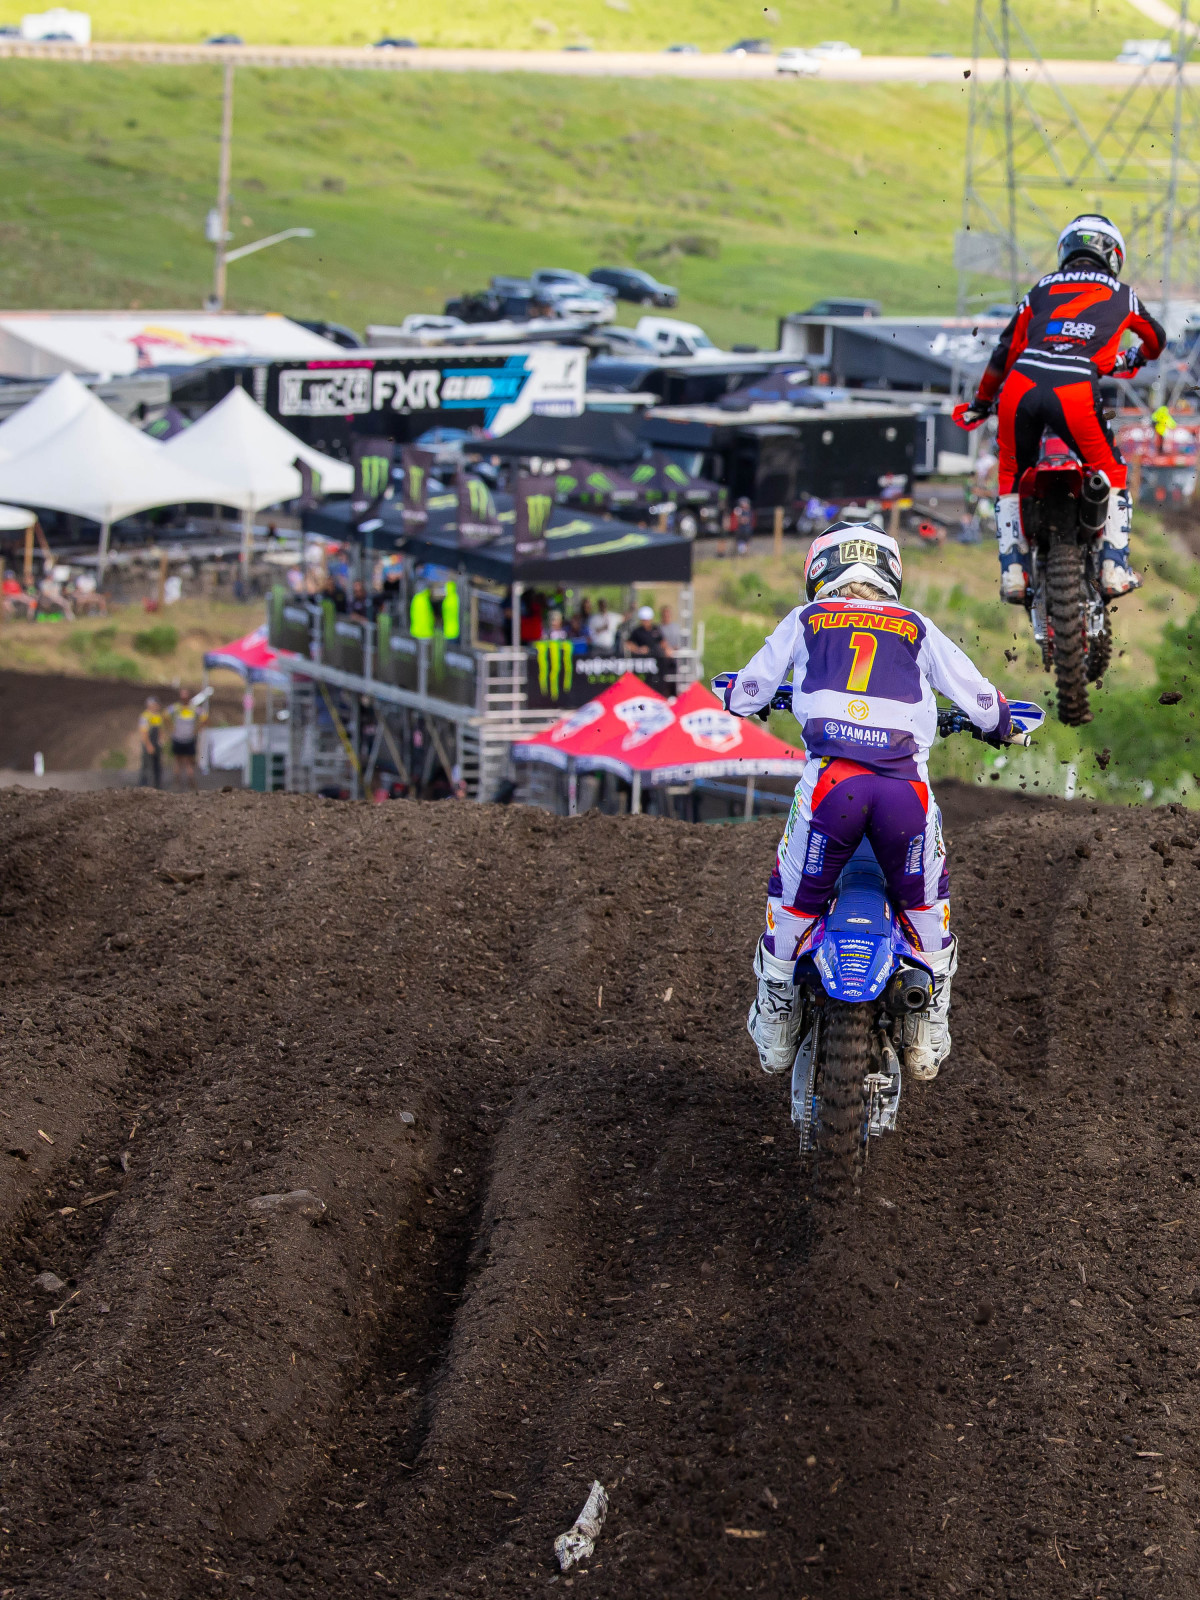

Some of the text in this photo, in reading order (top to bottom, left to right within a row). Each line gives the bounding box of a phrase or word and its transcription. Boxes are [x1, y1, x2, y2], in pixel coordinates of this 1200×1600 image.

[1038, 272, 1121, 293] CANNON
[1048, 282, 1114, 320] 7
[373, 370, 442, 411] FXR
[811, 561, 825, 576] BELL
[808, 612, 919, 645] TURNER
[845, 631, 878, 693] 1
[829, 735, 884, 748] RACING
[839, 724, 889, 743] YAMAHA
[909, 841, 922, 874] YAMAHA
